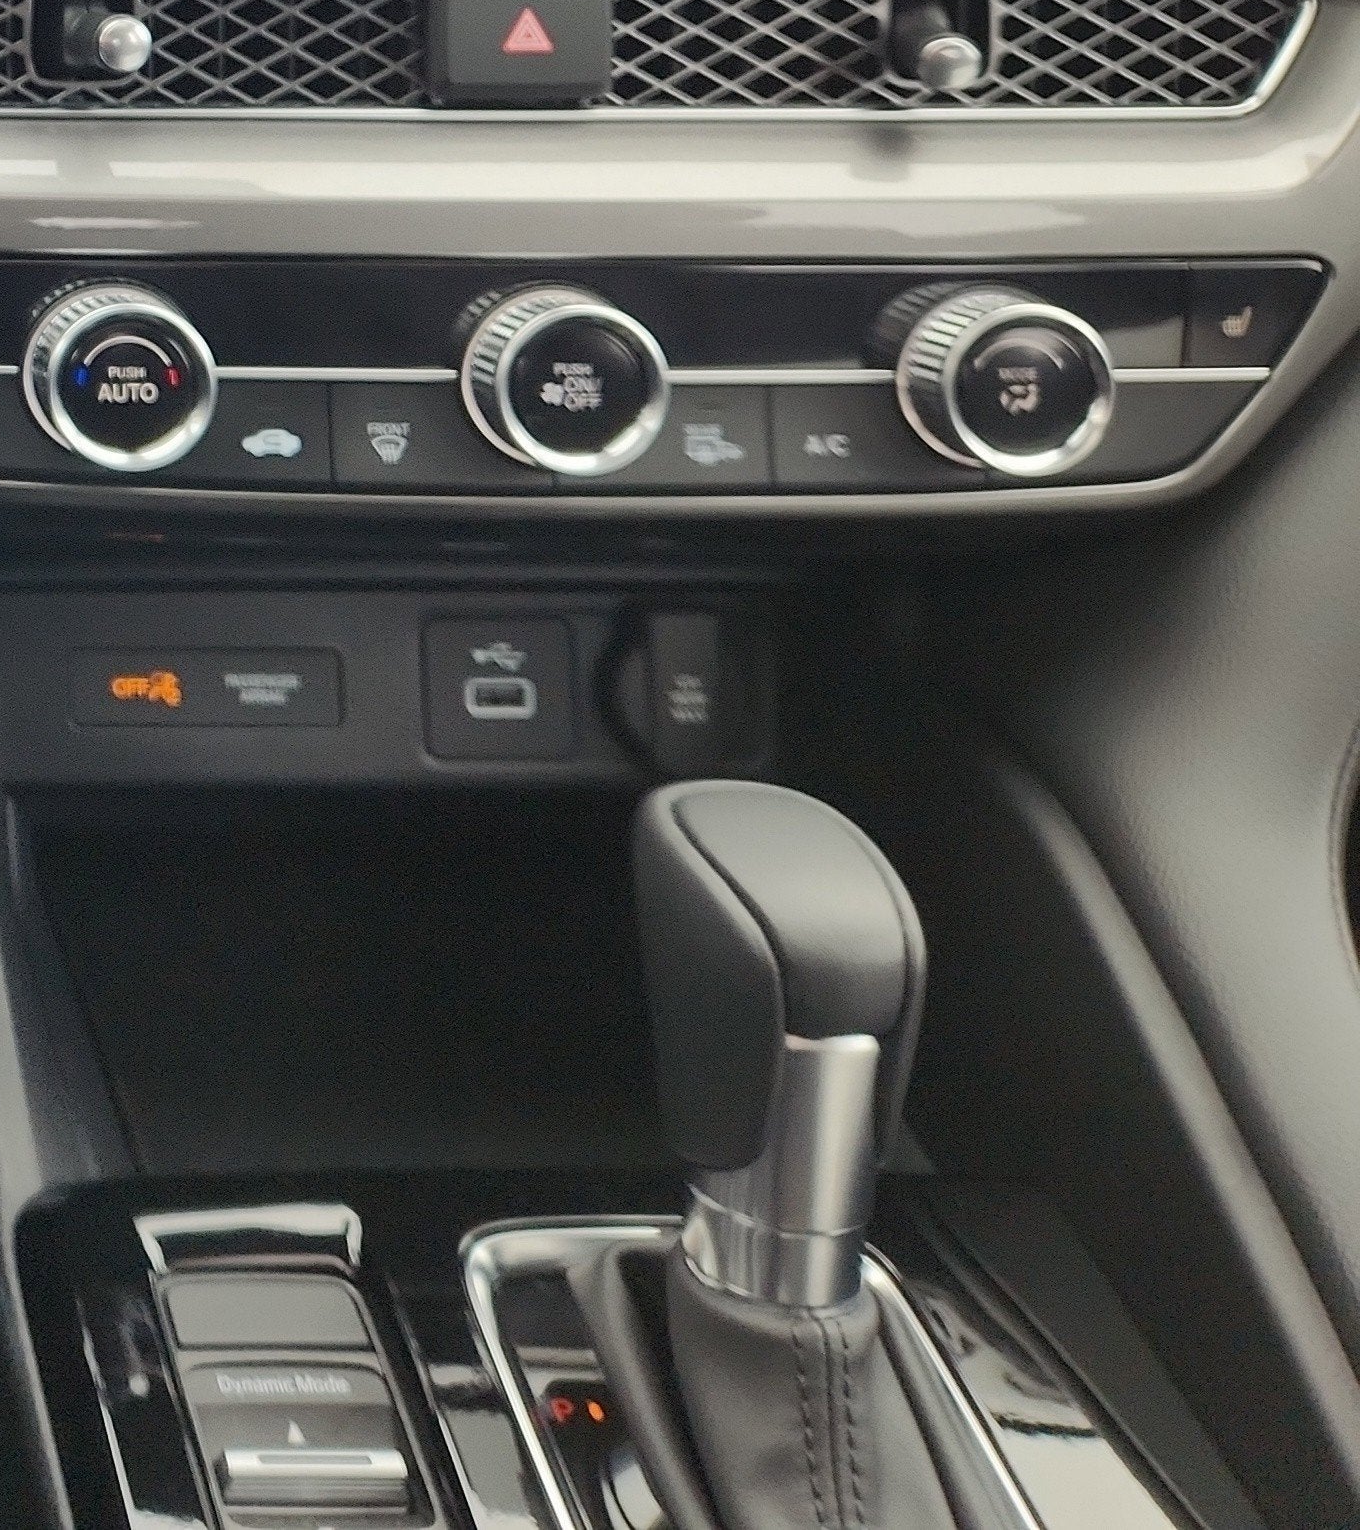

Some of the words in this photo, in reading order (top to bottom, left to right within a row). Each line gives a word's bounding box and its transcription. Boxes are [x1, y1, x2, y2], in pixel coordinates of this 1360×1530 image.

[107, 366, 147, 379] PUSH
[97, 382, 159, 404] AUTO
[216, 1374, 292, 1398] Dynamic
[293, 1374, 352, 1395] Mode
